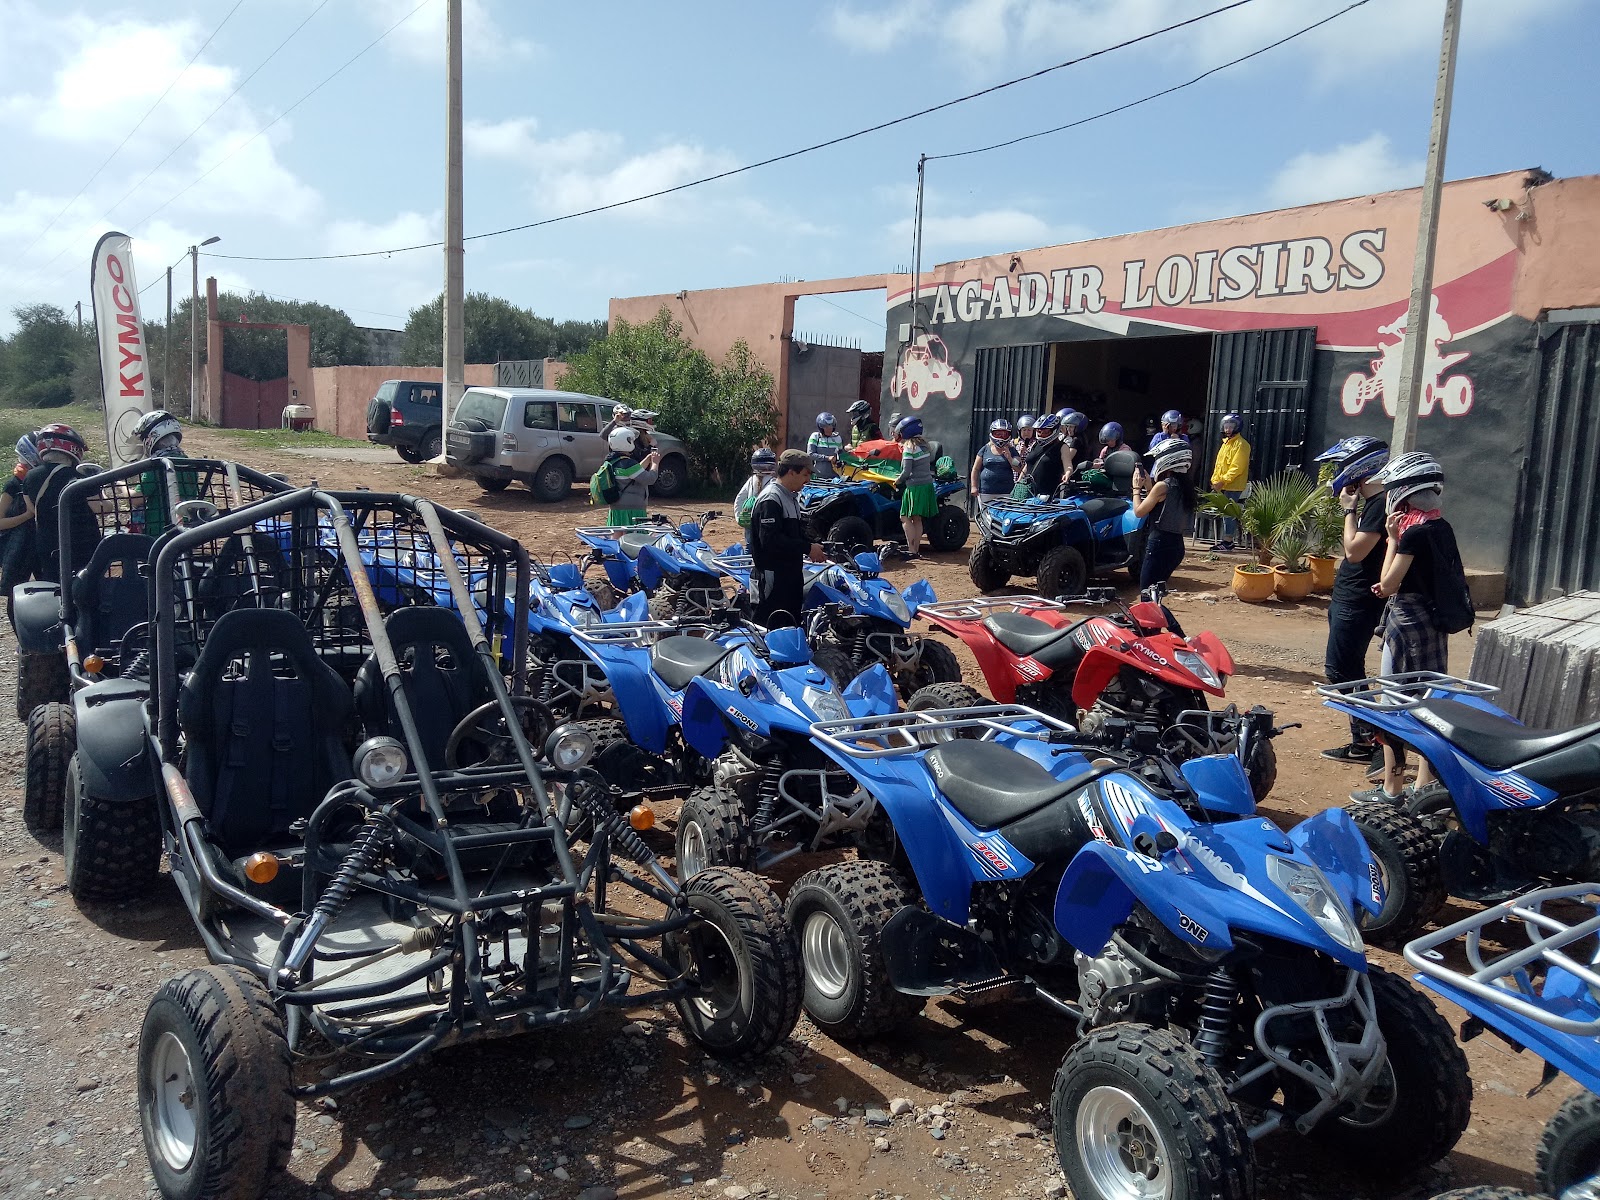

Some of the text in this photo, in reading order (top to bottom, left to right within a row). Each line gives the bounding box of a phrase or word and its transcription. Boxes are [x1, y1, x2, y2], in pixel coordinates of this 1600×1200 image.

[929, 228, 1386, 325] AGADIR LOISIRS
[106, 253, 145, 397] KYMCO
[1132, 641, 1168, 665] KYMCO
[1016, 662, 1039, 677] 300
[762, 674, 793, 704] KYMCO
[732, 710, 758, 730] IPONE
[1420, 709, 1448, 732] KYMCO
[930, 754, 944, 778] KYMCO
[1486, 779, 1532, 800] 300
[972, 841, 1009, 871] 300
[1125, 850, 1164, 874] 19
[1184, 830, 1248, 885] KYMCO
